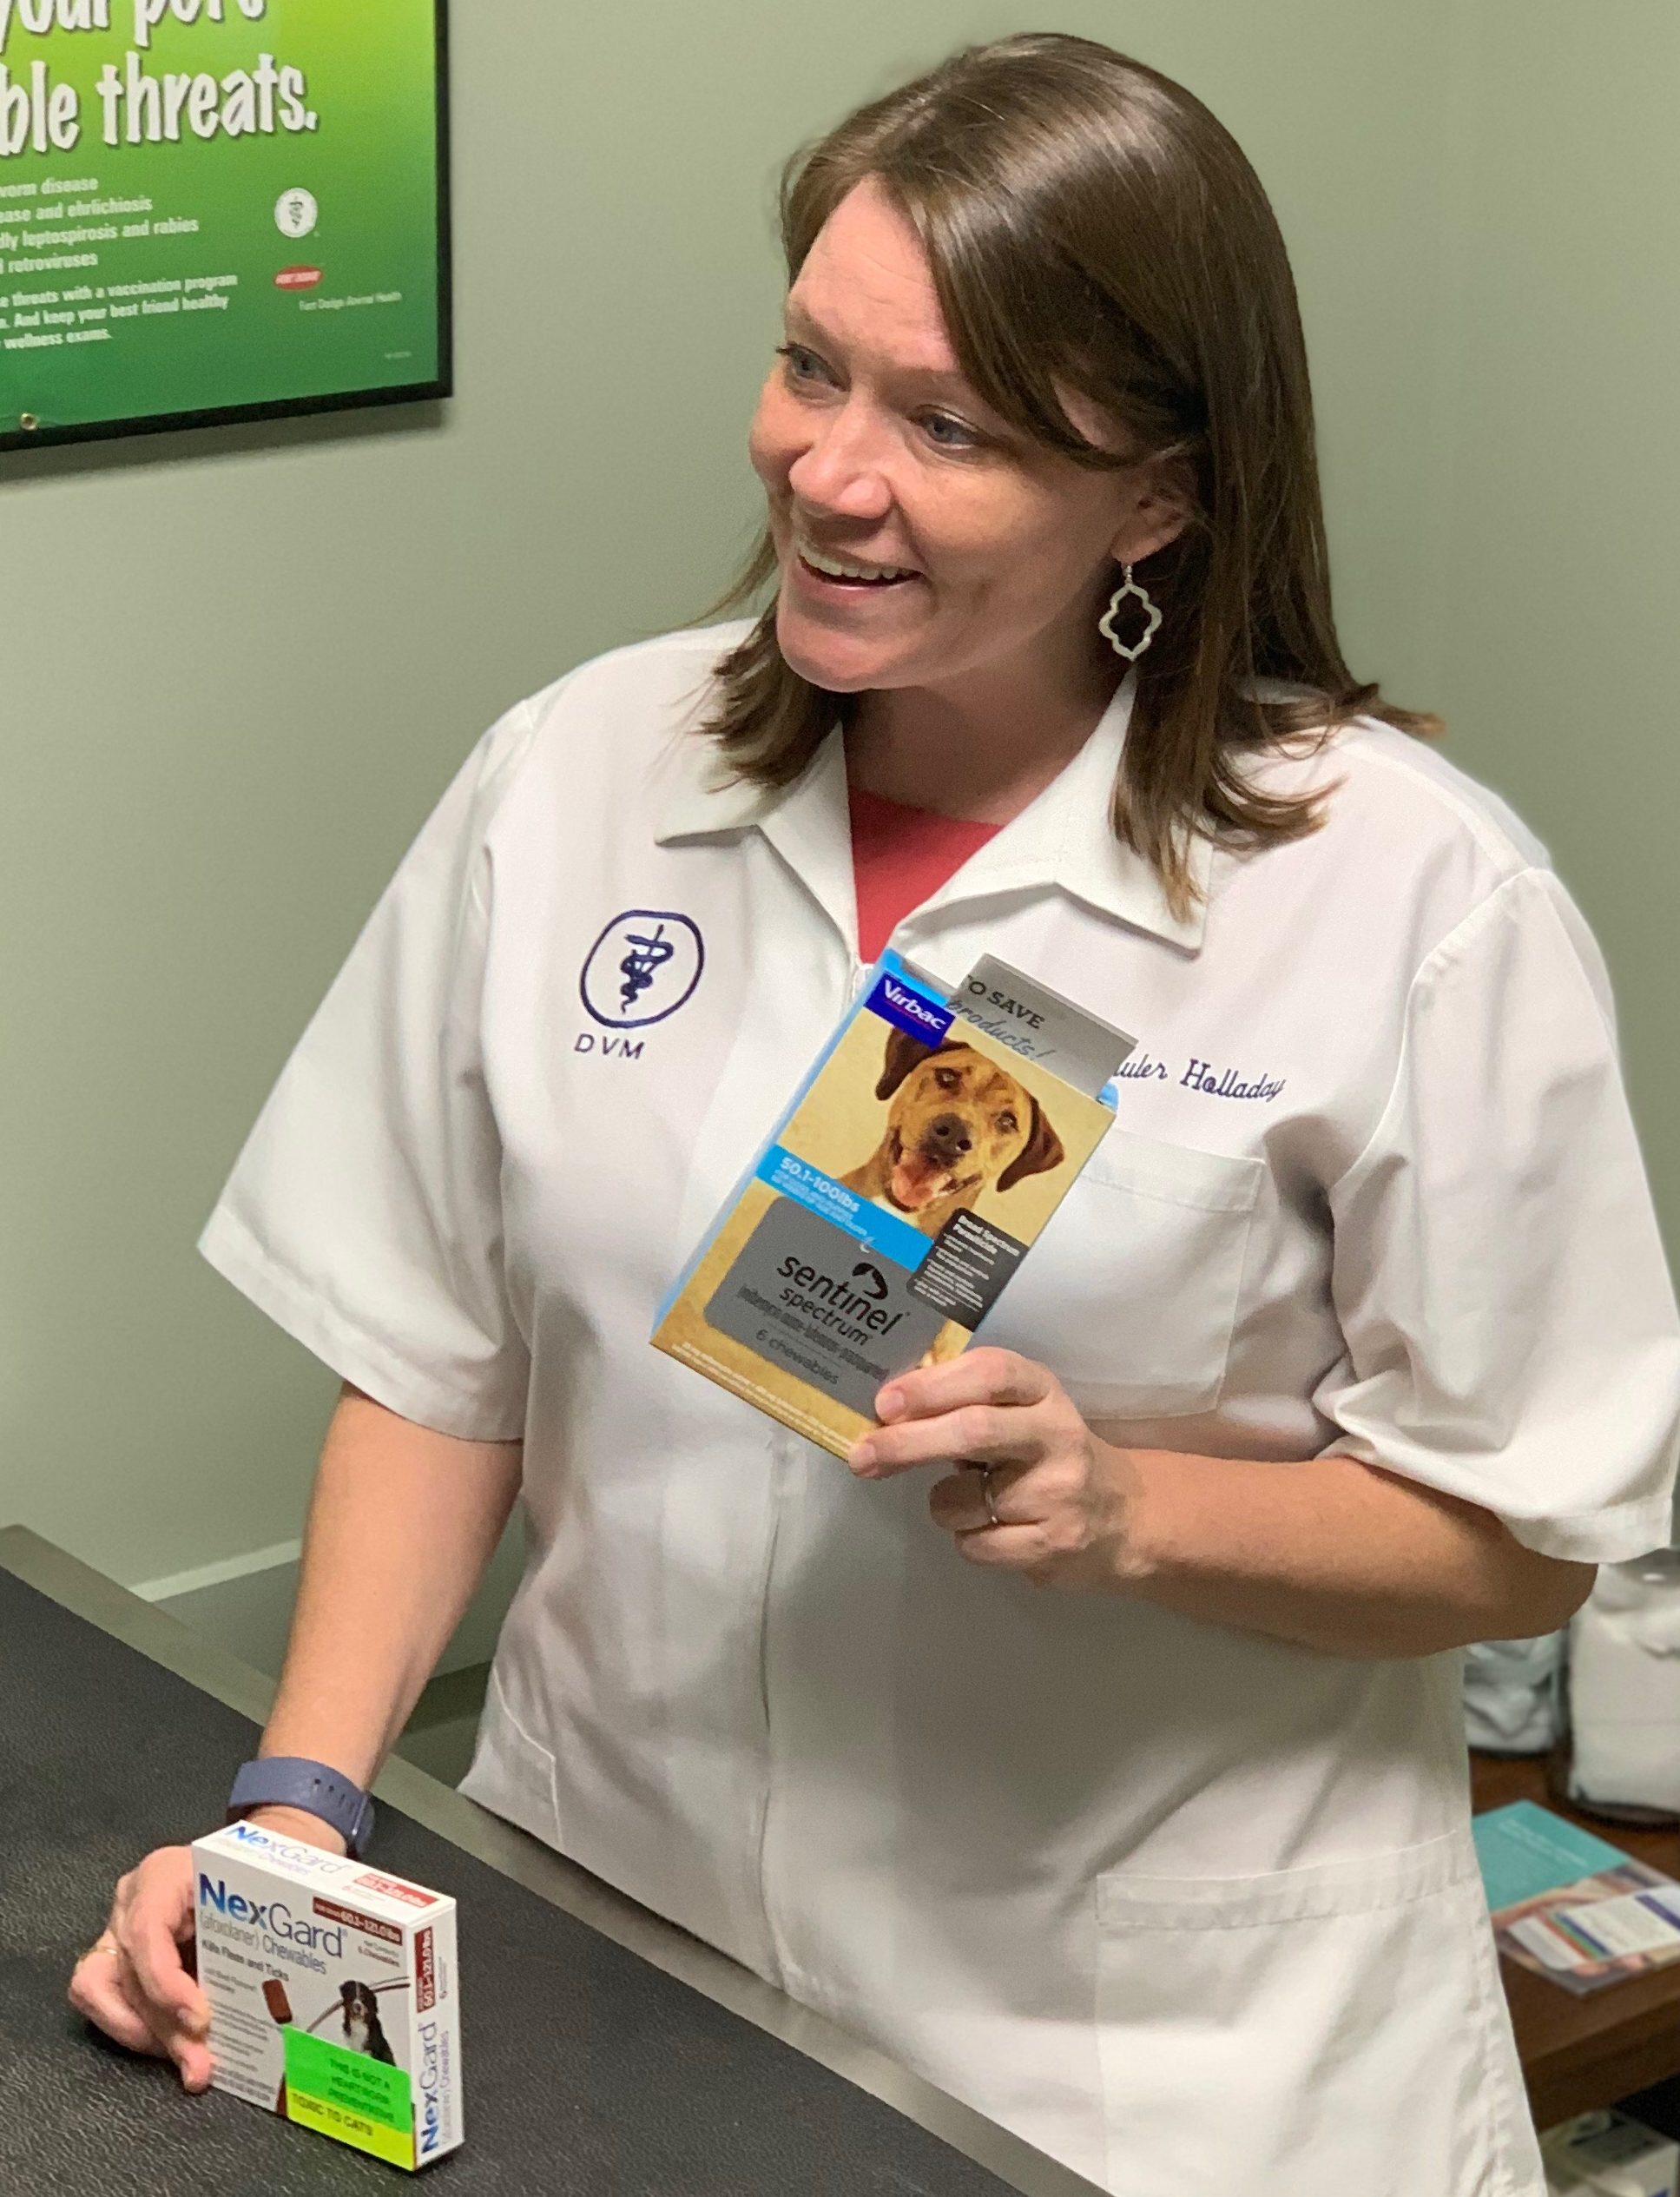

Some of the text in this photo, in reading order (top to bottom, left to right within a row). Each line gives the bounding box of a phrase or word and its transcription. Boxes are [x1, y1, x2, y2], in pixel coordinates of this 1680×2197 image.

[95, 50, 319, 146] threats.
[41, 177, 99, 195] disease
[22, 223, 118, 249] leptospirosis
[122, 219, 149, 237] and
[154, 217, 200, 234] rabies
[36, 202, 63, 220] and
[8, 254, 98, 274] retroviruses
[12, 292, 59, 307] threats
[63, 286, 93, 301] with
[95, 287, 105, 299] a
[107, 278, 181, 297] vaccination
[185, 275, 238, 293] program
[14, 311, 40, 327] And
[43, 309, 76, 326] keep
[77, 308, 107, 324] your
[109, 304, 138, 317] best
[142, 298, 180, 313] friend
[3, 333, 63, 349] wellness
[883, 978, 946, 1031] Virbac
[967, 973, 1045, 1031] O SAVE
[574, 1033, 645, 1059] DVM
[1179, 1057, 1287, 1103] Holladay
[776, 1256, 904, 1336] sentinel
[779, 1286, 870, 1347] spectrum
[755, 1329, 840, 1385] 6 chewables
[226, 1824, 344, 1875] NexGard
[199, 1872, 343, 1959] NexGard
[247, 1956, 264, 1972] and
[265, 1963, 290, 1982] Ticks
[262, 1934, 327, 1975] Chewables
[418, 2021, 439, 2154] NexGard
[291, 2092, 373, 2136] TOXIC TO CATS
